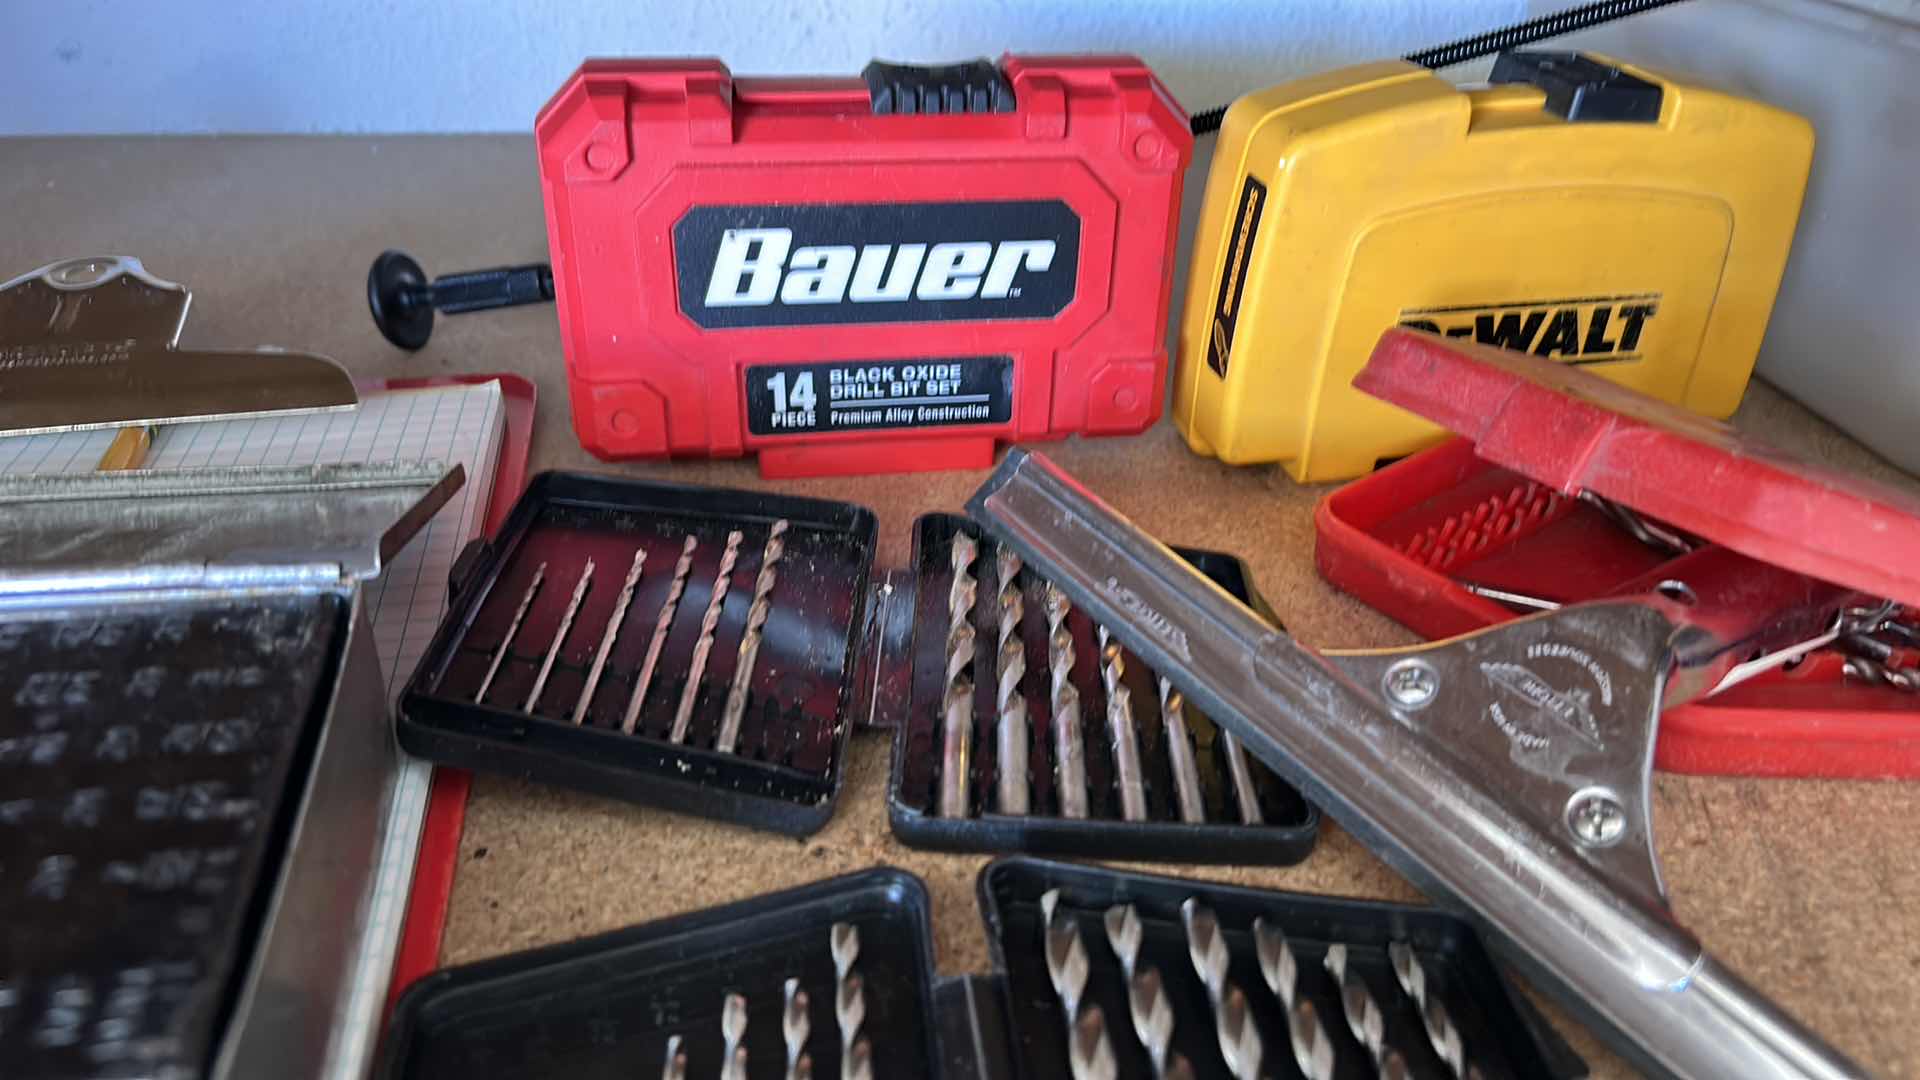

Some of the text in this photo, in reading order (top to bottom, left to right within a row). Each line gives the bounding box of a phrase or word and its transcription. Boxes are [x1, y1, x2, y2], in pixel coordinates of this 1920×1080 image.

[704, 227, 1056, 307] Bauer
[830, 364, 962, 384] BLACK OXIDE
[766, 371, 817, 412] 14
[830, 379, 961, 399] DRILL BIT SET
[771, 410, 817, 428] PIECE
[831, 404, 990, 425] Premium Alloy Construction
